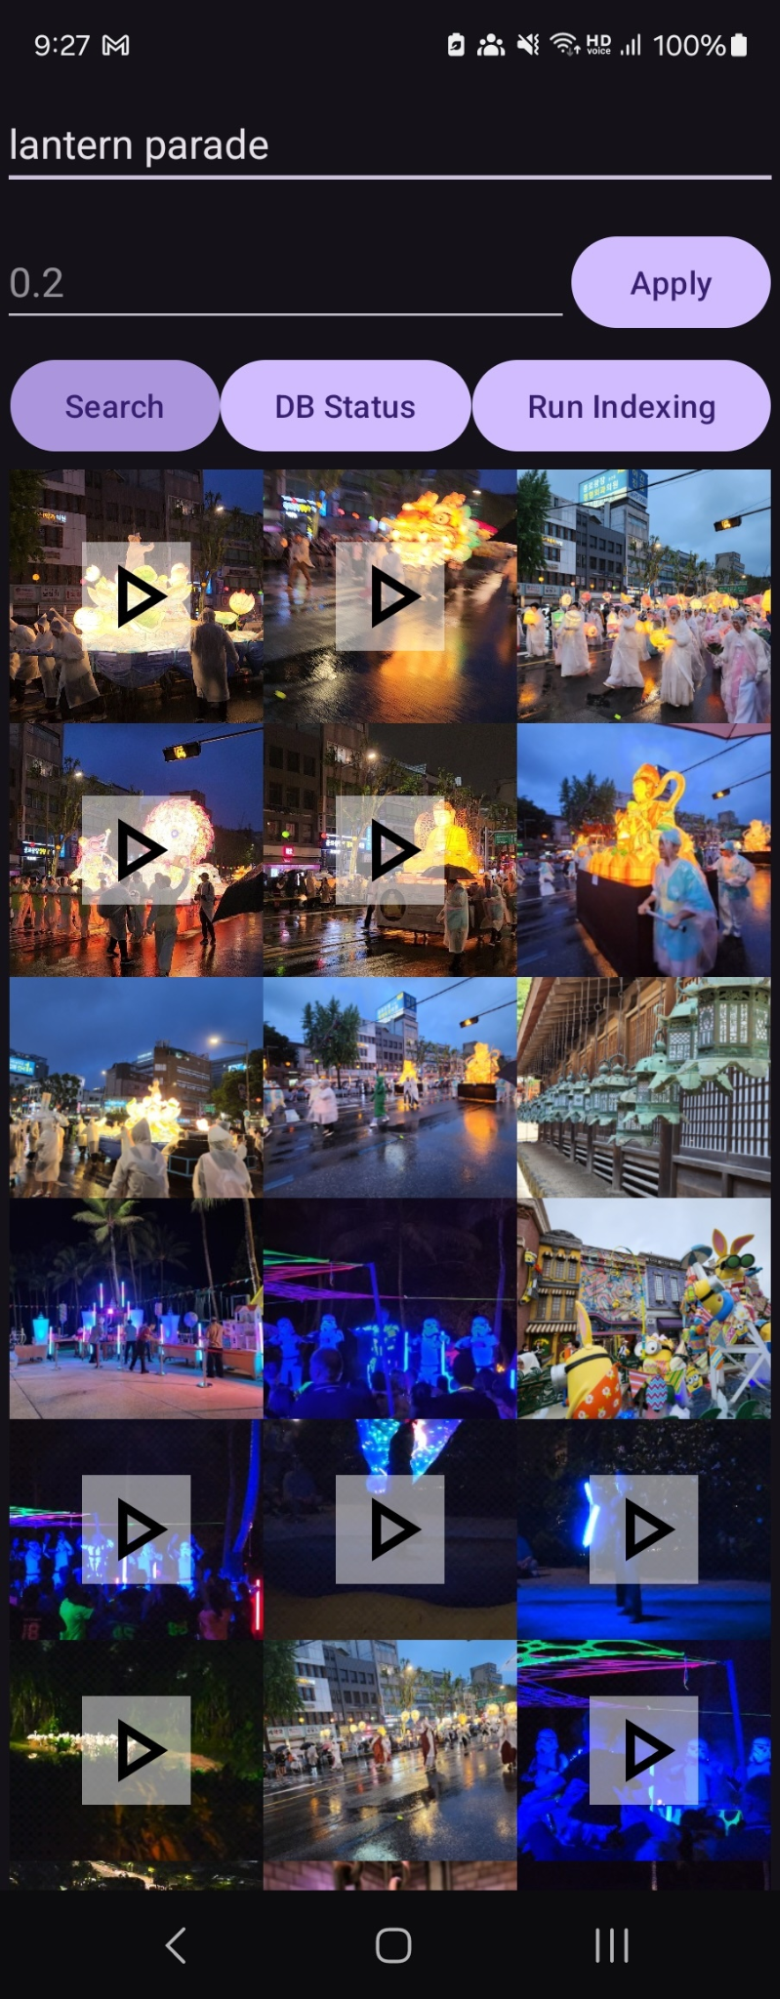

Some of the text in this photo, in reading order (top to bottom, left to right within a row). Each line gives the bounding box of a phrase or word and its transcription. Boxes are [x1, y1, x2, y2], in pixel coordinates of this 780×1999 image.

[35, 34, 90, 56] 9:27
[586, 34, 611, 47] HD
[586, 46, 611, 55] voice
[653, 34, 726, 56] 100%
[10, 128, 268, 168] lantern parade
[10, 267, 63, 298] 0.2
[630, 270, 712, 302] Apply
[66, 393, 163, 418] Search
[276, 394, 415, 418] DB Status
[529, 393, 715, 425] Run Indexing
